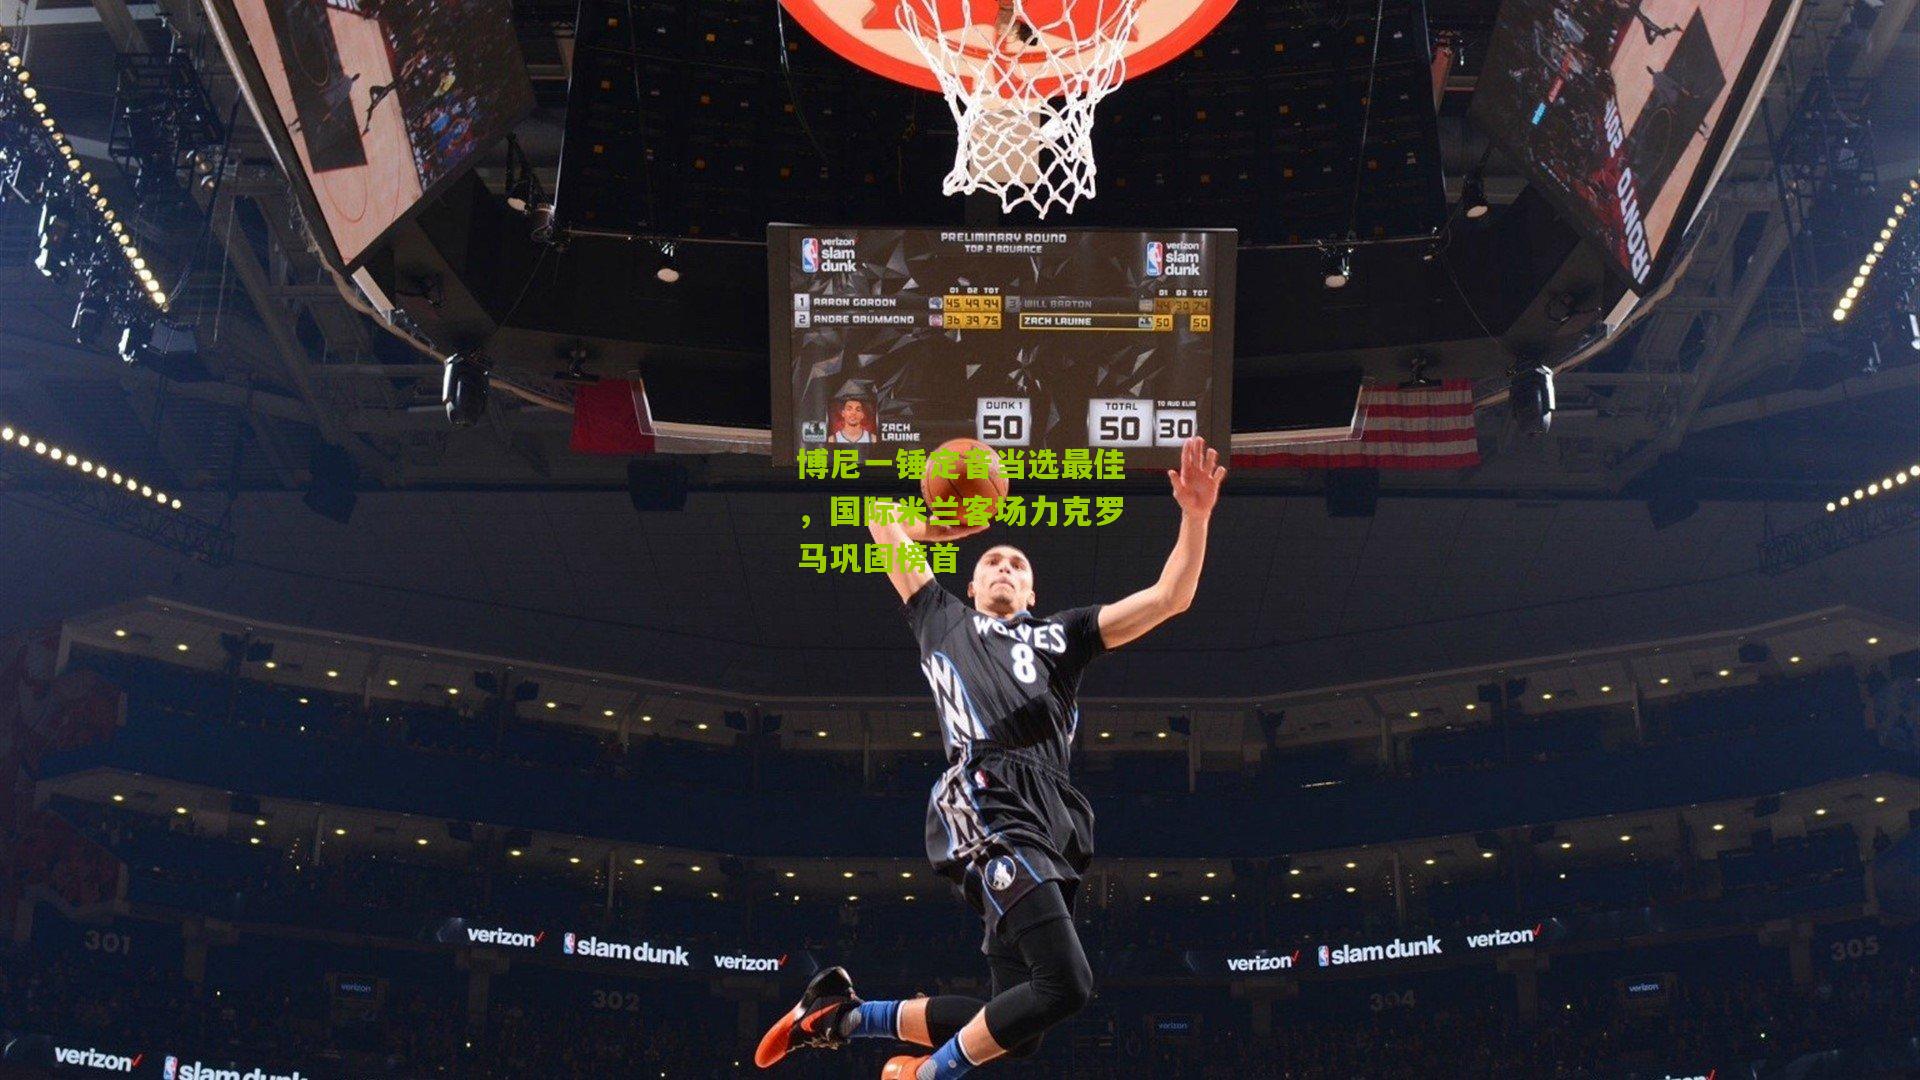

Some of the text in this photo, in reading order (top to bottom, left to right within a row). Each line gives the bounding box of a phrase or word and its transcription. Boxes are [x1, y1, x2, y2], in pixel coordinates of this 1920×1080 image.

[821, 237, 855, 246] verizon
[941, 232, 1067, 243] PRELIMINARY ROUND
[965, 245, 984, 253] TOP
[986, 245, 992, 253] 2
[1166, 241, 1199, 250] verizon
[821, 246, 856, 260] slam
[1166, 250, 1199, 263] slam
[821, 259, 857, 272] dunk
[1165, 263, 1200, 276] dunk
[813, 298, 850, 307] AARON
[853, 298, 897, 307] GORDON
[946, 299, 960, 308] 45
[965, 299, 979, 308] 49
[984, 299, 998, 308] 94
[799, 315, 806, 324] 2
[813, 315, 850, 324] ANDRE
[852, 315, 915, 325] DRUMMOND
[966, 316, 979, 325] 39
[984, 316, 998, 326] 75
[1024, 317, 1208, 327] ZACH LAVINE 50 50
[986, 401, 1014, 410] DUNK
[1105, 402, 1138, 411] TOTAL
[882, 423, 911, 432] ZACH
[983, 415, 1023, 440] 50
[1100, 416, 1140, 441] 50
[1159, 419, 1193, 438] 30
[882, 433, 920, 441] LAVINE
[973, 615, 1067, 654] WOLVES
[1011, 643, 1037, 683] 8
[84, 931, 130, 955] 301
[467, 927, 536, 948] verizon
[1466, 928, 1534, 948] verizon
[577, 937, 690, 966] slam dunk
[1331, 935, 1443, 965] slam dunk
[714, 954, 779, 971] verizon
[1227, 953, 1292, 971] verizon
[55, 1047, 132, 1072] verizon
